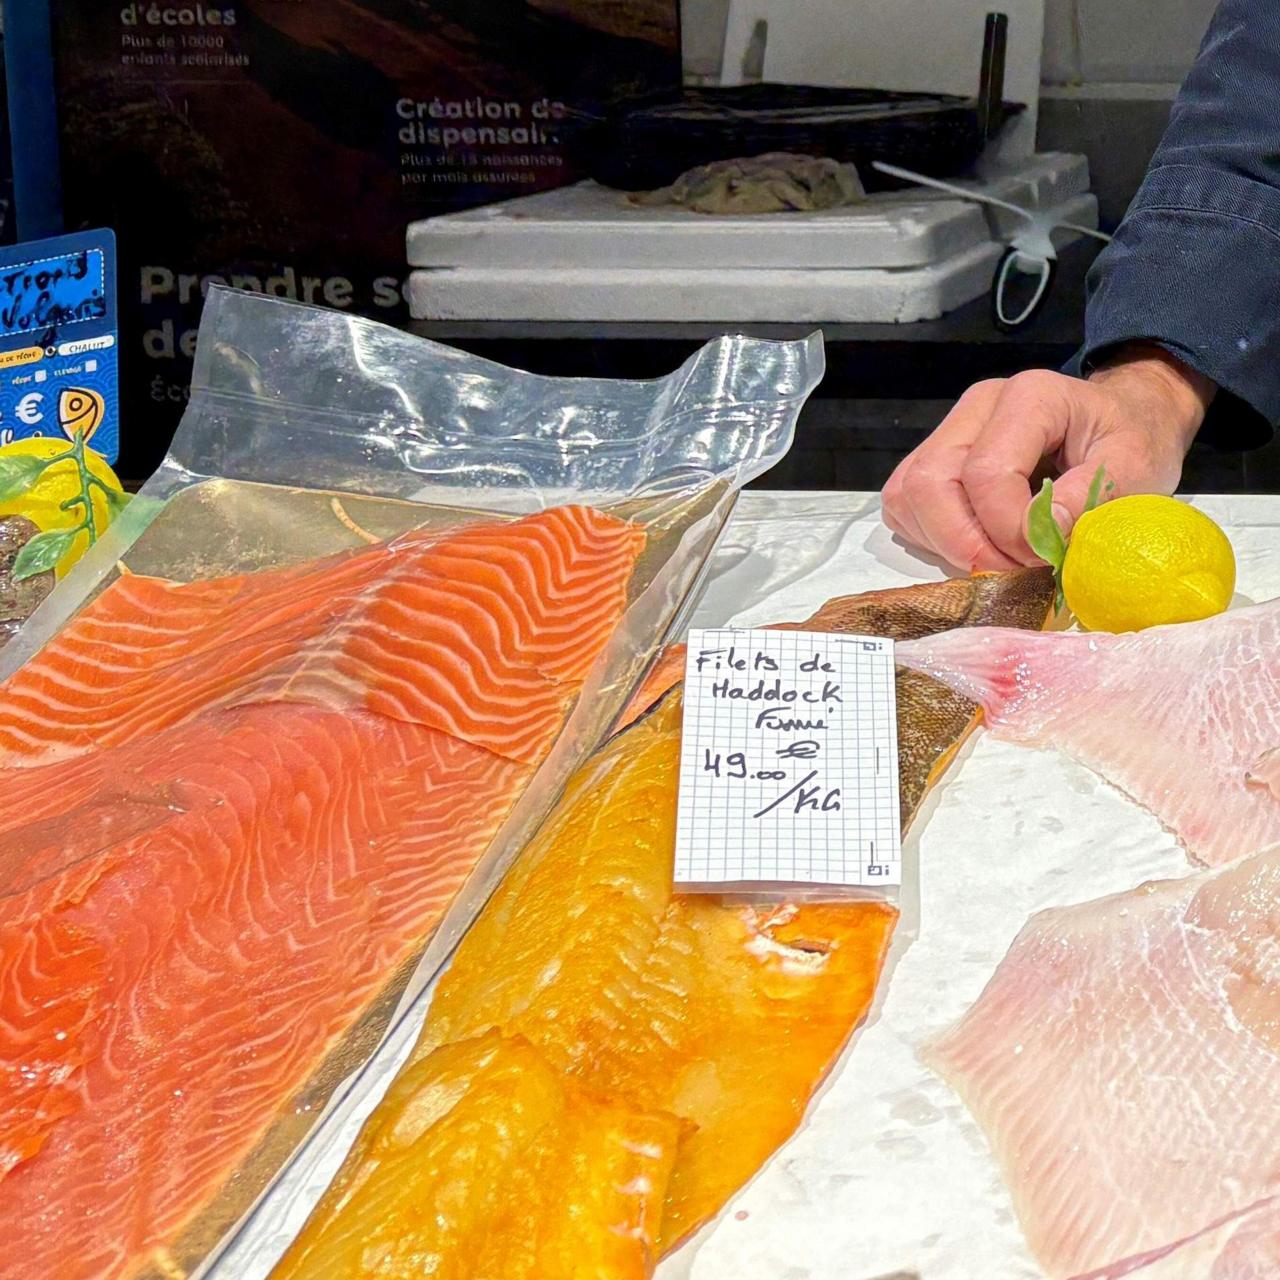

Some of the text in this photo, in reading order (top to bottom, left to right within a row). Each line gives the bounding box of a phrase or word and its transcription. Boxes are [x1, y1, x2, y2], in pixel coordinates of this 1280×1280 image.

[120, 2, 238, 27] d'écoles
[395, 95, 522, 120] Création
[14, 392, 45, 425] €
[695, 646, 836, 674] Filets de
[711, 678, 844, 704] Haddock
